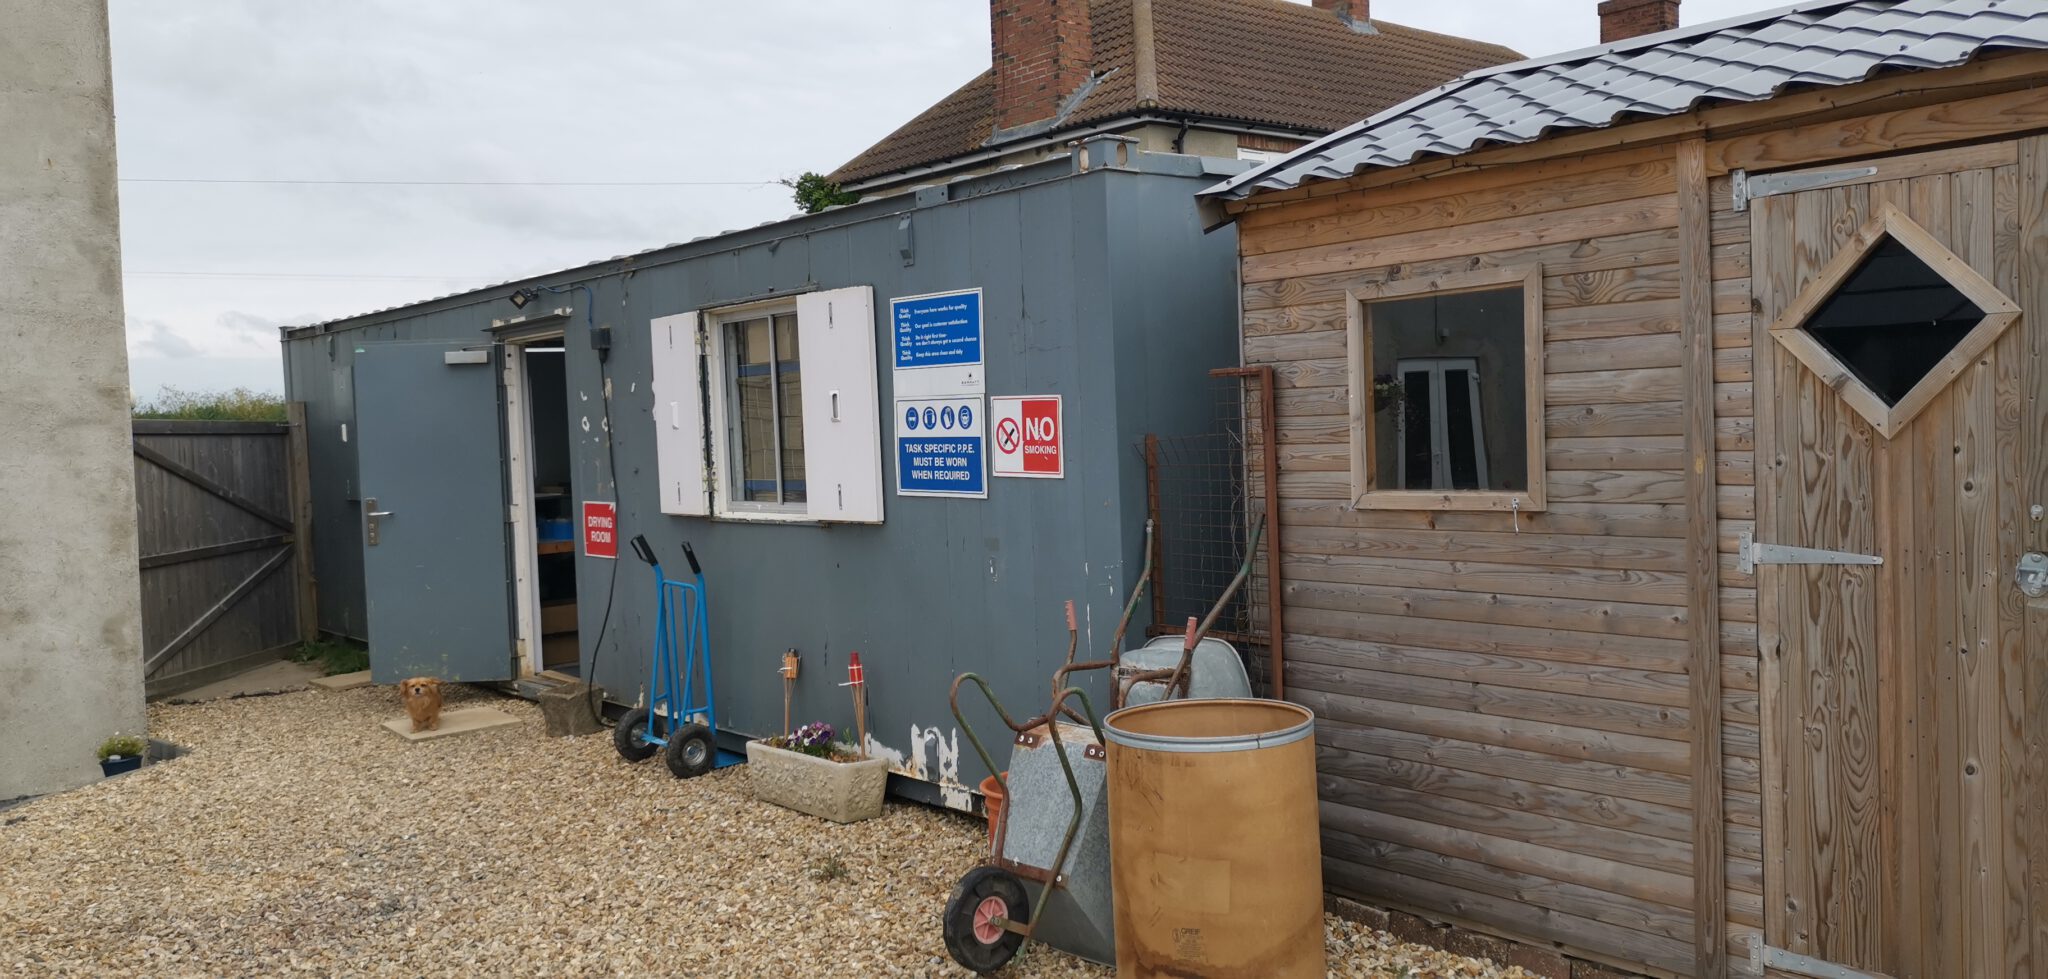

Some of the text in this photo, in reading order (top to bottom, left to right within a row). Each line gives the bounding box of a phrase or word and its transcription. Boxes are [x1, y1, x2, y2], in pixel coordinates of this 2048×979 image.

[1026, 416, 1054, 442] NO
[904, 444, 974, 453] TASK SPECIFIC P.P.E.
[1024, 445, 1056, 454] SMOKING
[913, 457, 968, 466] MUST BE WORN
[912, 470, 970, 480] WHEN REQUIRED
[588, 516, 612, 528] DRYING
[591, 530, 612, 544] ROOM
